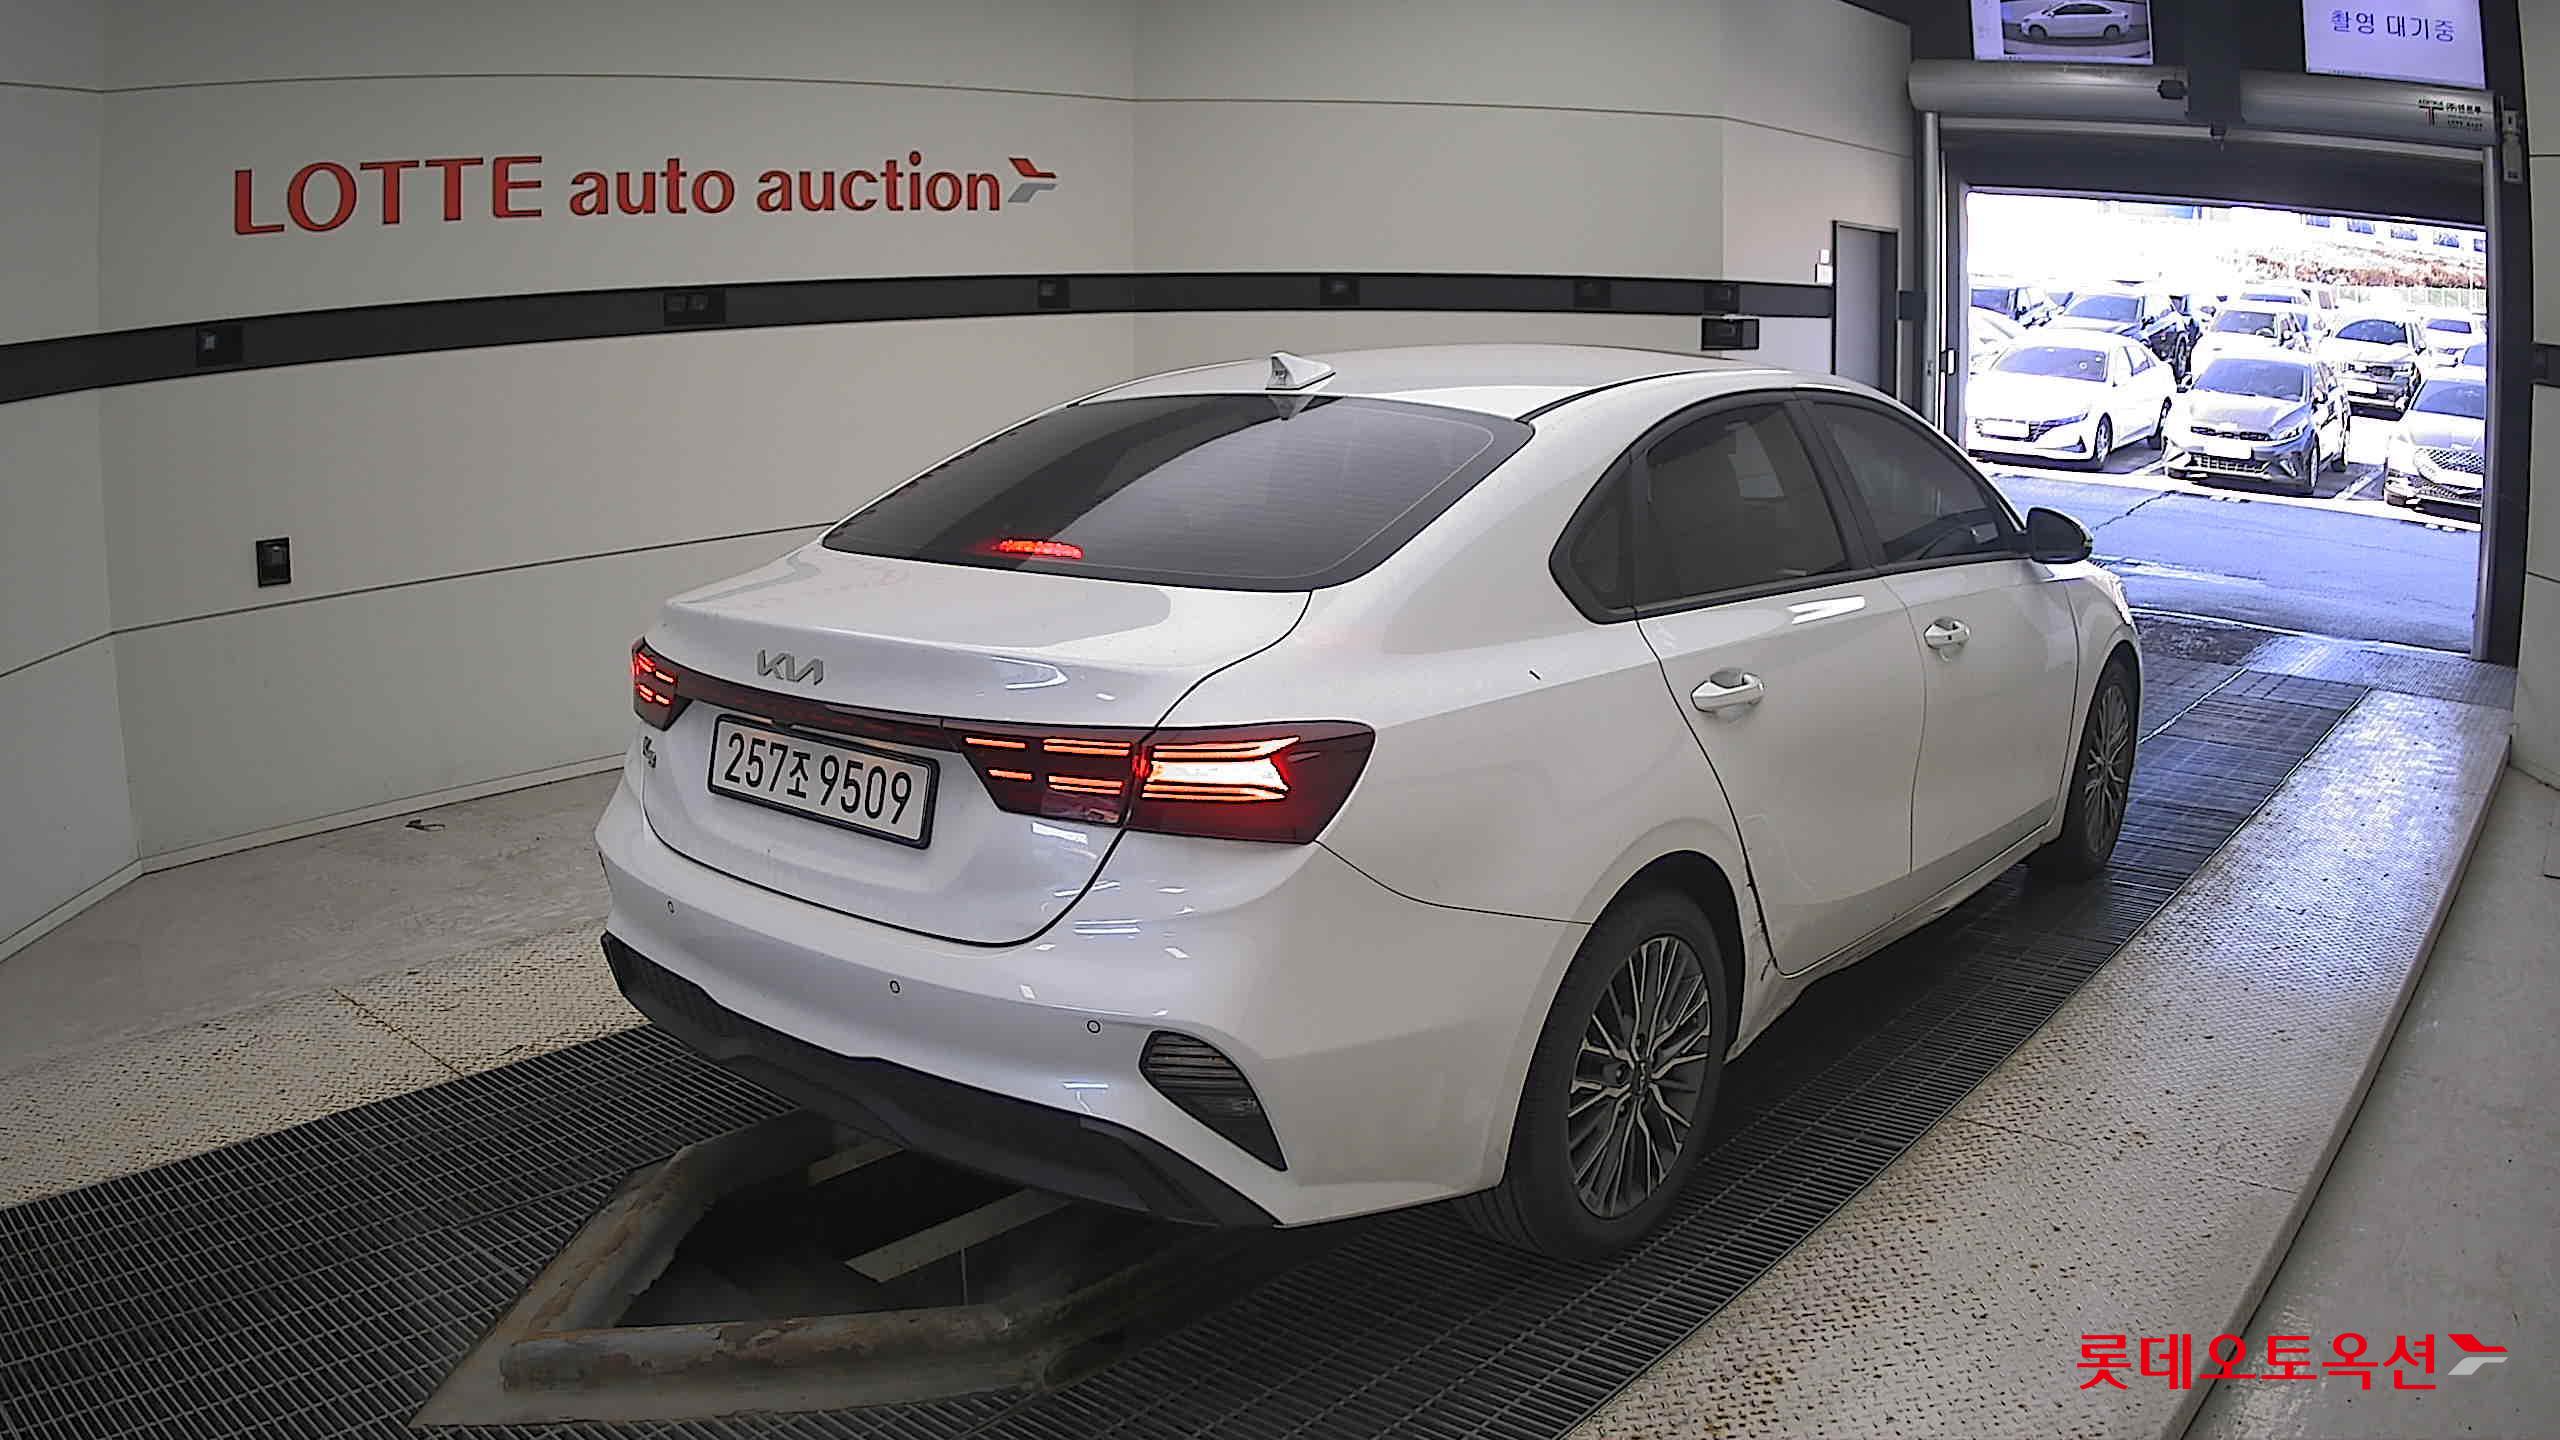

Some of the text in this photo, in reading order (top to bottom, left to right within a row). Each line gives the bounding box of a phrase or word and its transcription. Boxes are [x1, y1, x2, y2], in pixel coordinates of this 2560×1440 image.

[2386, 15, 2455, 42] 대기중
[234, 150, 1001, 236] LOTTE auto auction
